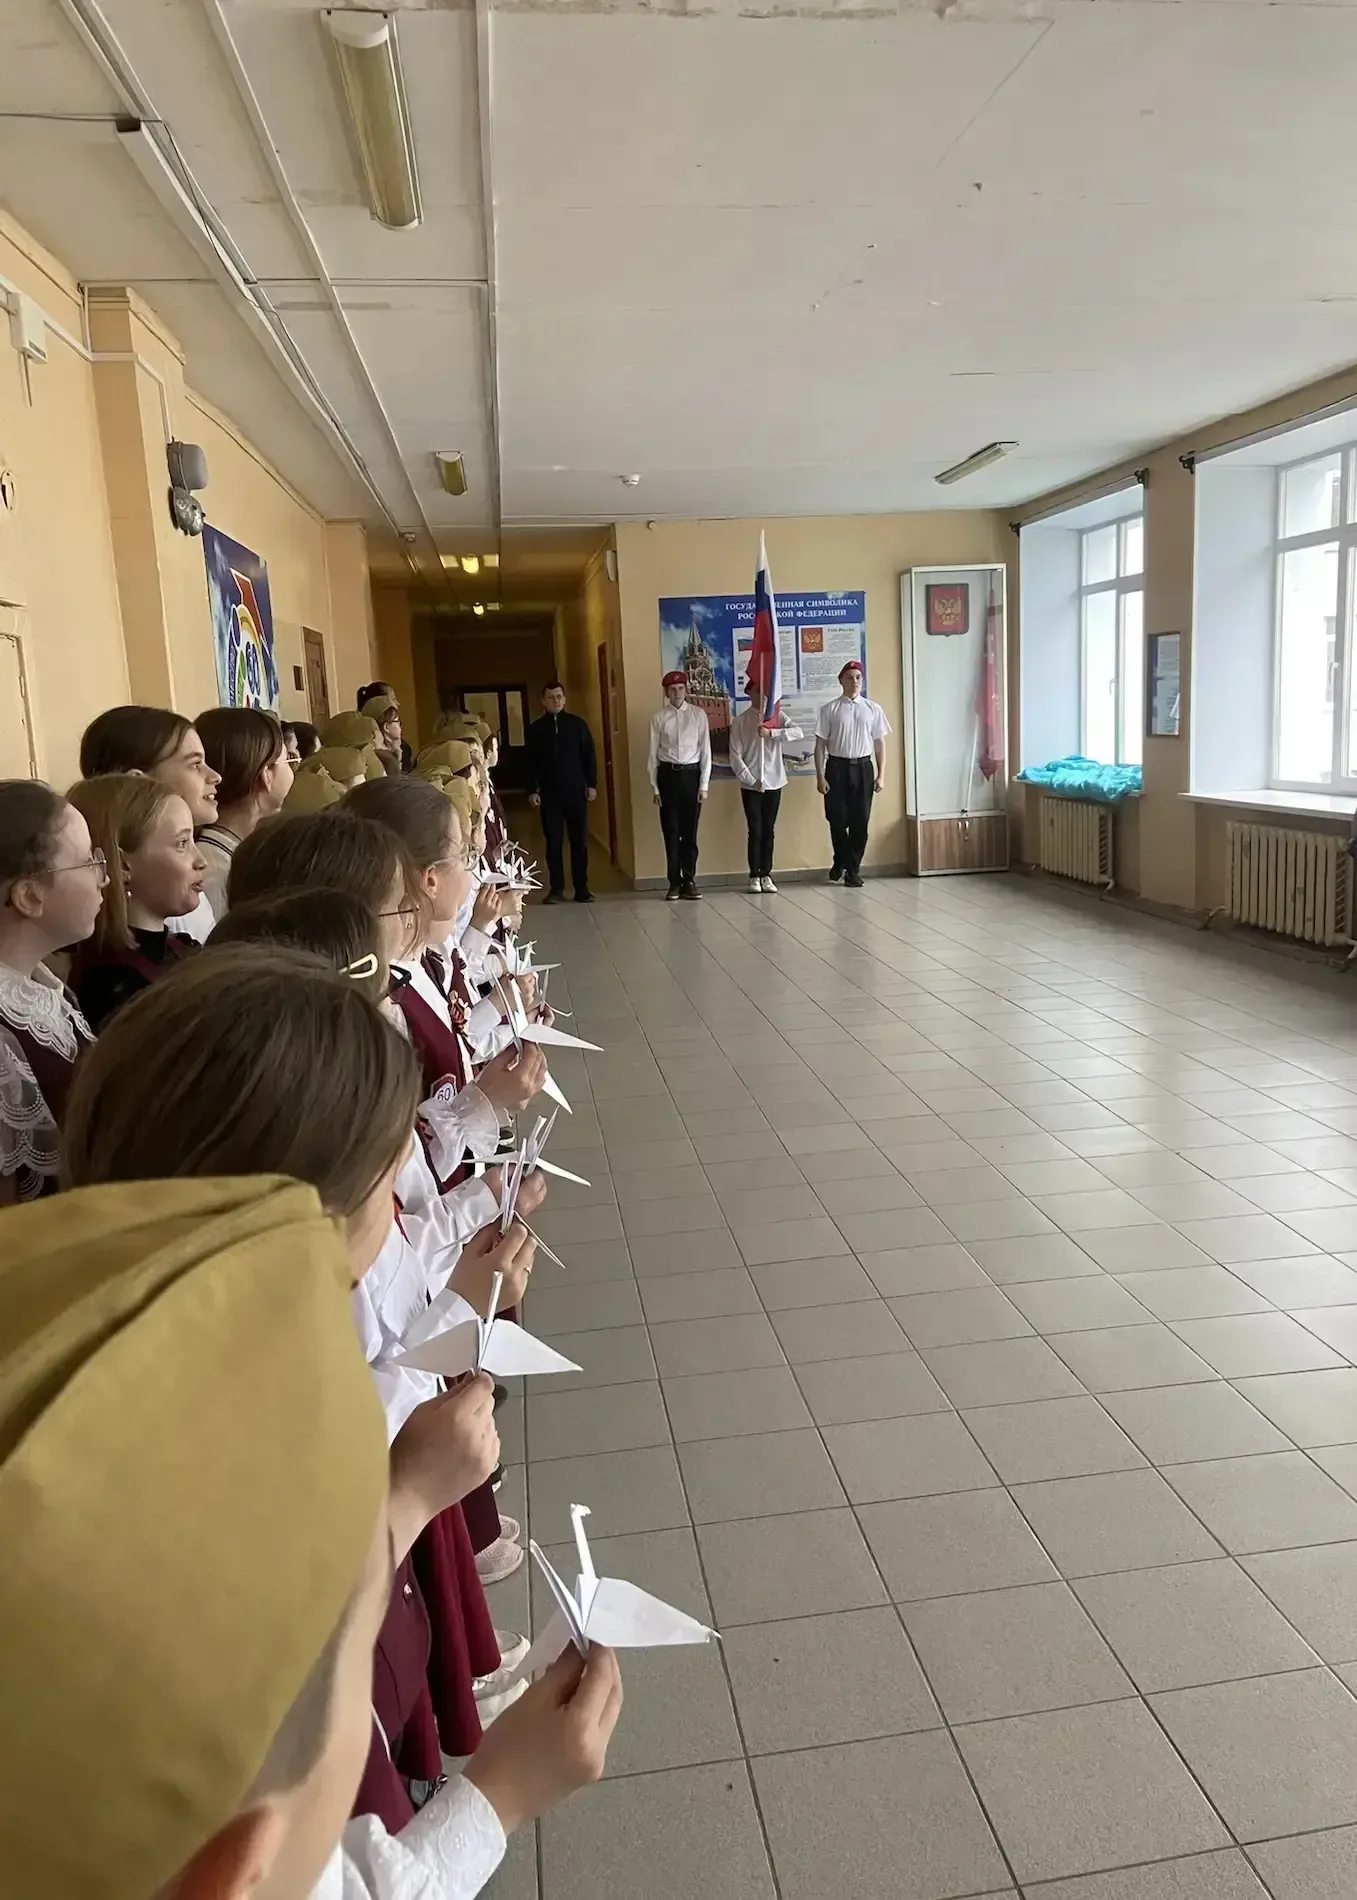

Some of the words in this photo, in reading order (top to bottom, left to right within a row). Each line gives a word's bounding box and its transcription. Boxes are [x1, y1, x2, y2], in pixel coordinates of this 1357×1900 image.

[725, 600, 804, 611] ГОСУДАЕННАЯ
[806, 599, 858, 608] СИМВОЛИКА
[737, 610, 794, 620] РОСКОЙ
[796, 609, 847, 618] ФЕДЕРАЦИИ
[437, 1088, 450, 1101] 60
